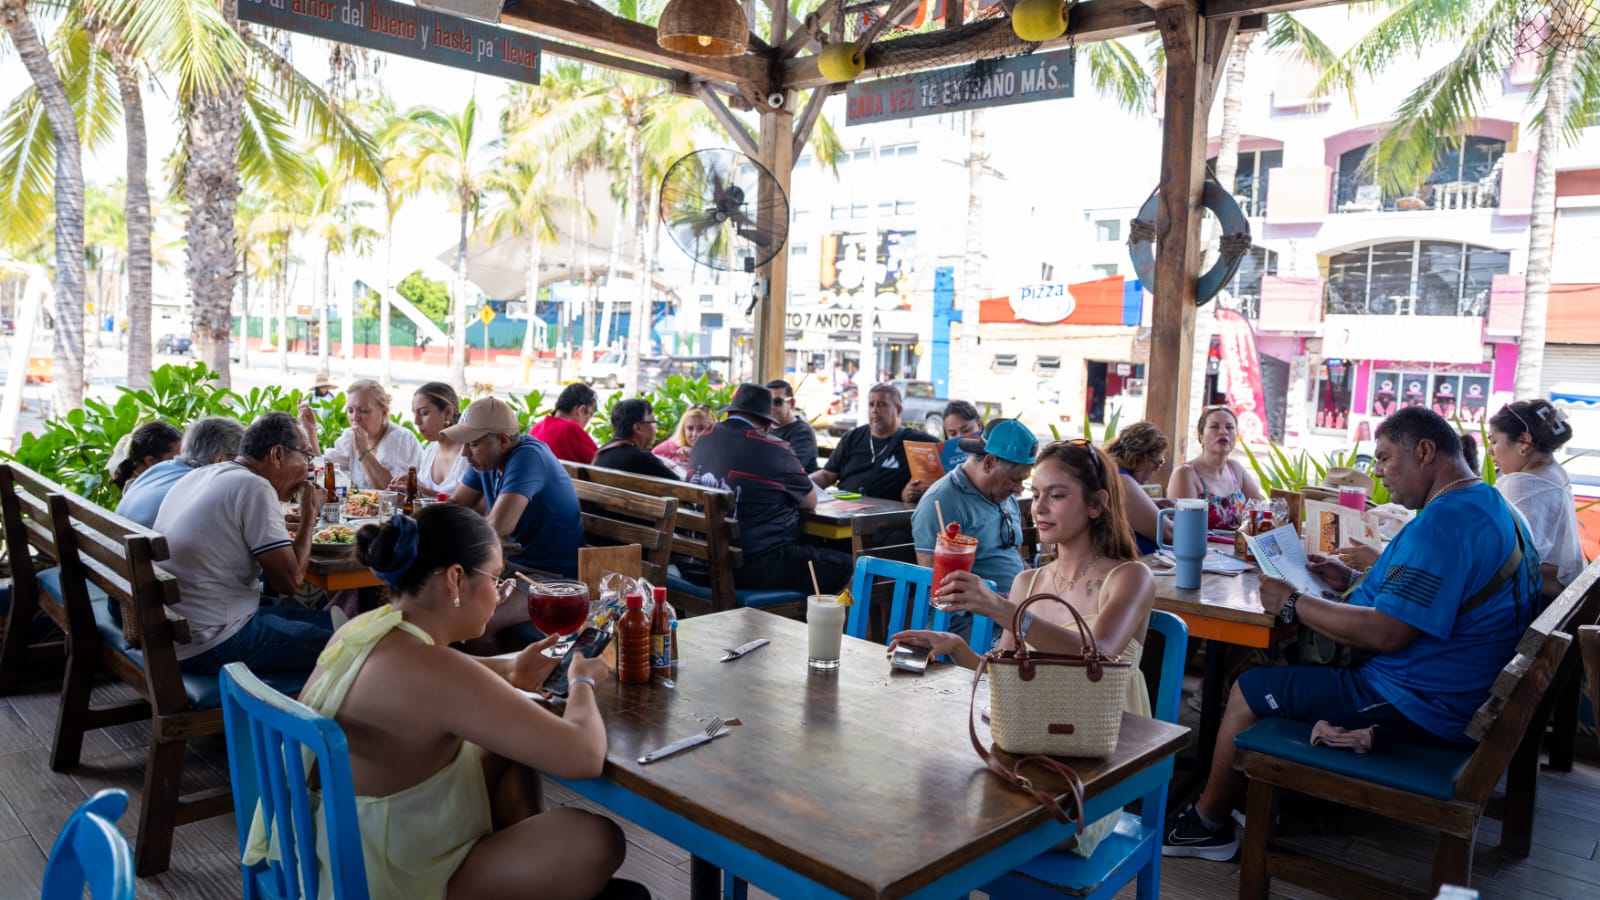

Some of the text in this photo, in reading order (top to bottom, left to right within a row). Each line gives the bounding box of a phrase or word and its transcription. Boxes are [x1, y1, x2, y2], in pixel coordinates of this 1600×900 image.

[292, 0, 336, 21] amor
[341, 2, 364, 27] del
[370, 9, 416, 40] bueno
[421, 24, 429, 51] y
[434, 20, 473, 54] hasta
[502, 38, 538, 69] llevar
[848, 93, 883, 118] CADA
[889, 87, 915, 113] VEZ
[921, 84, 938, 108] TE
[942, 68, 1014, 104] EXTRAÑO
[816, 313, 881, 331] ANTOJEA
